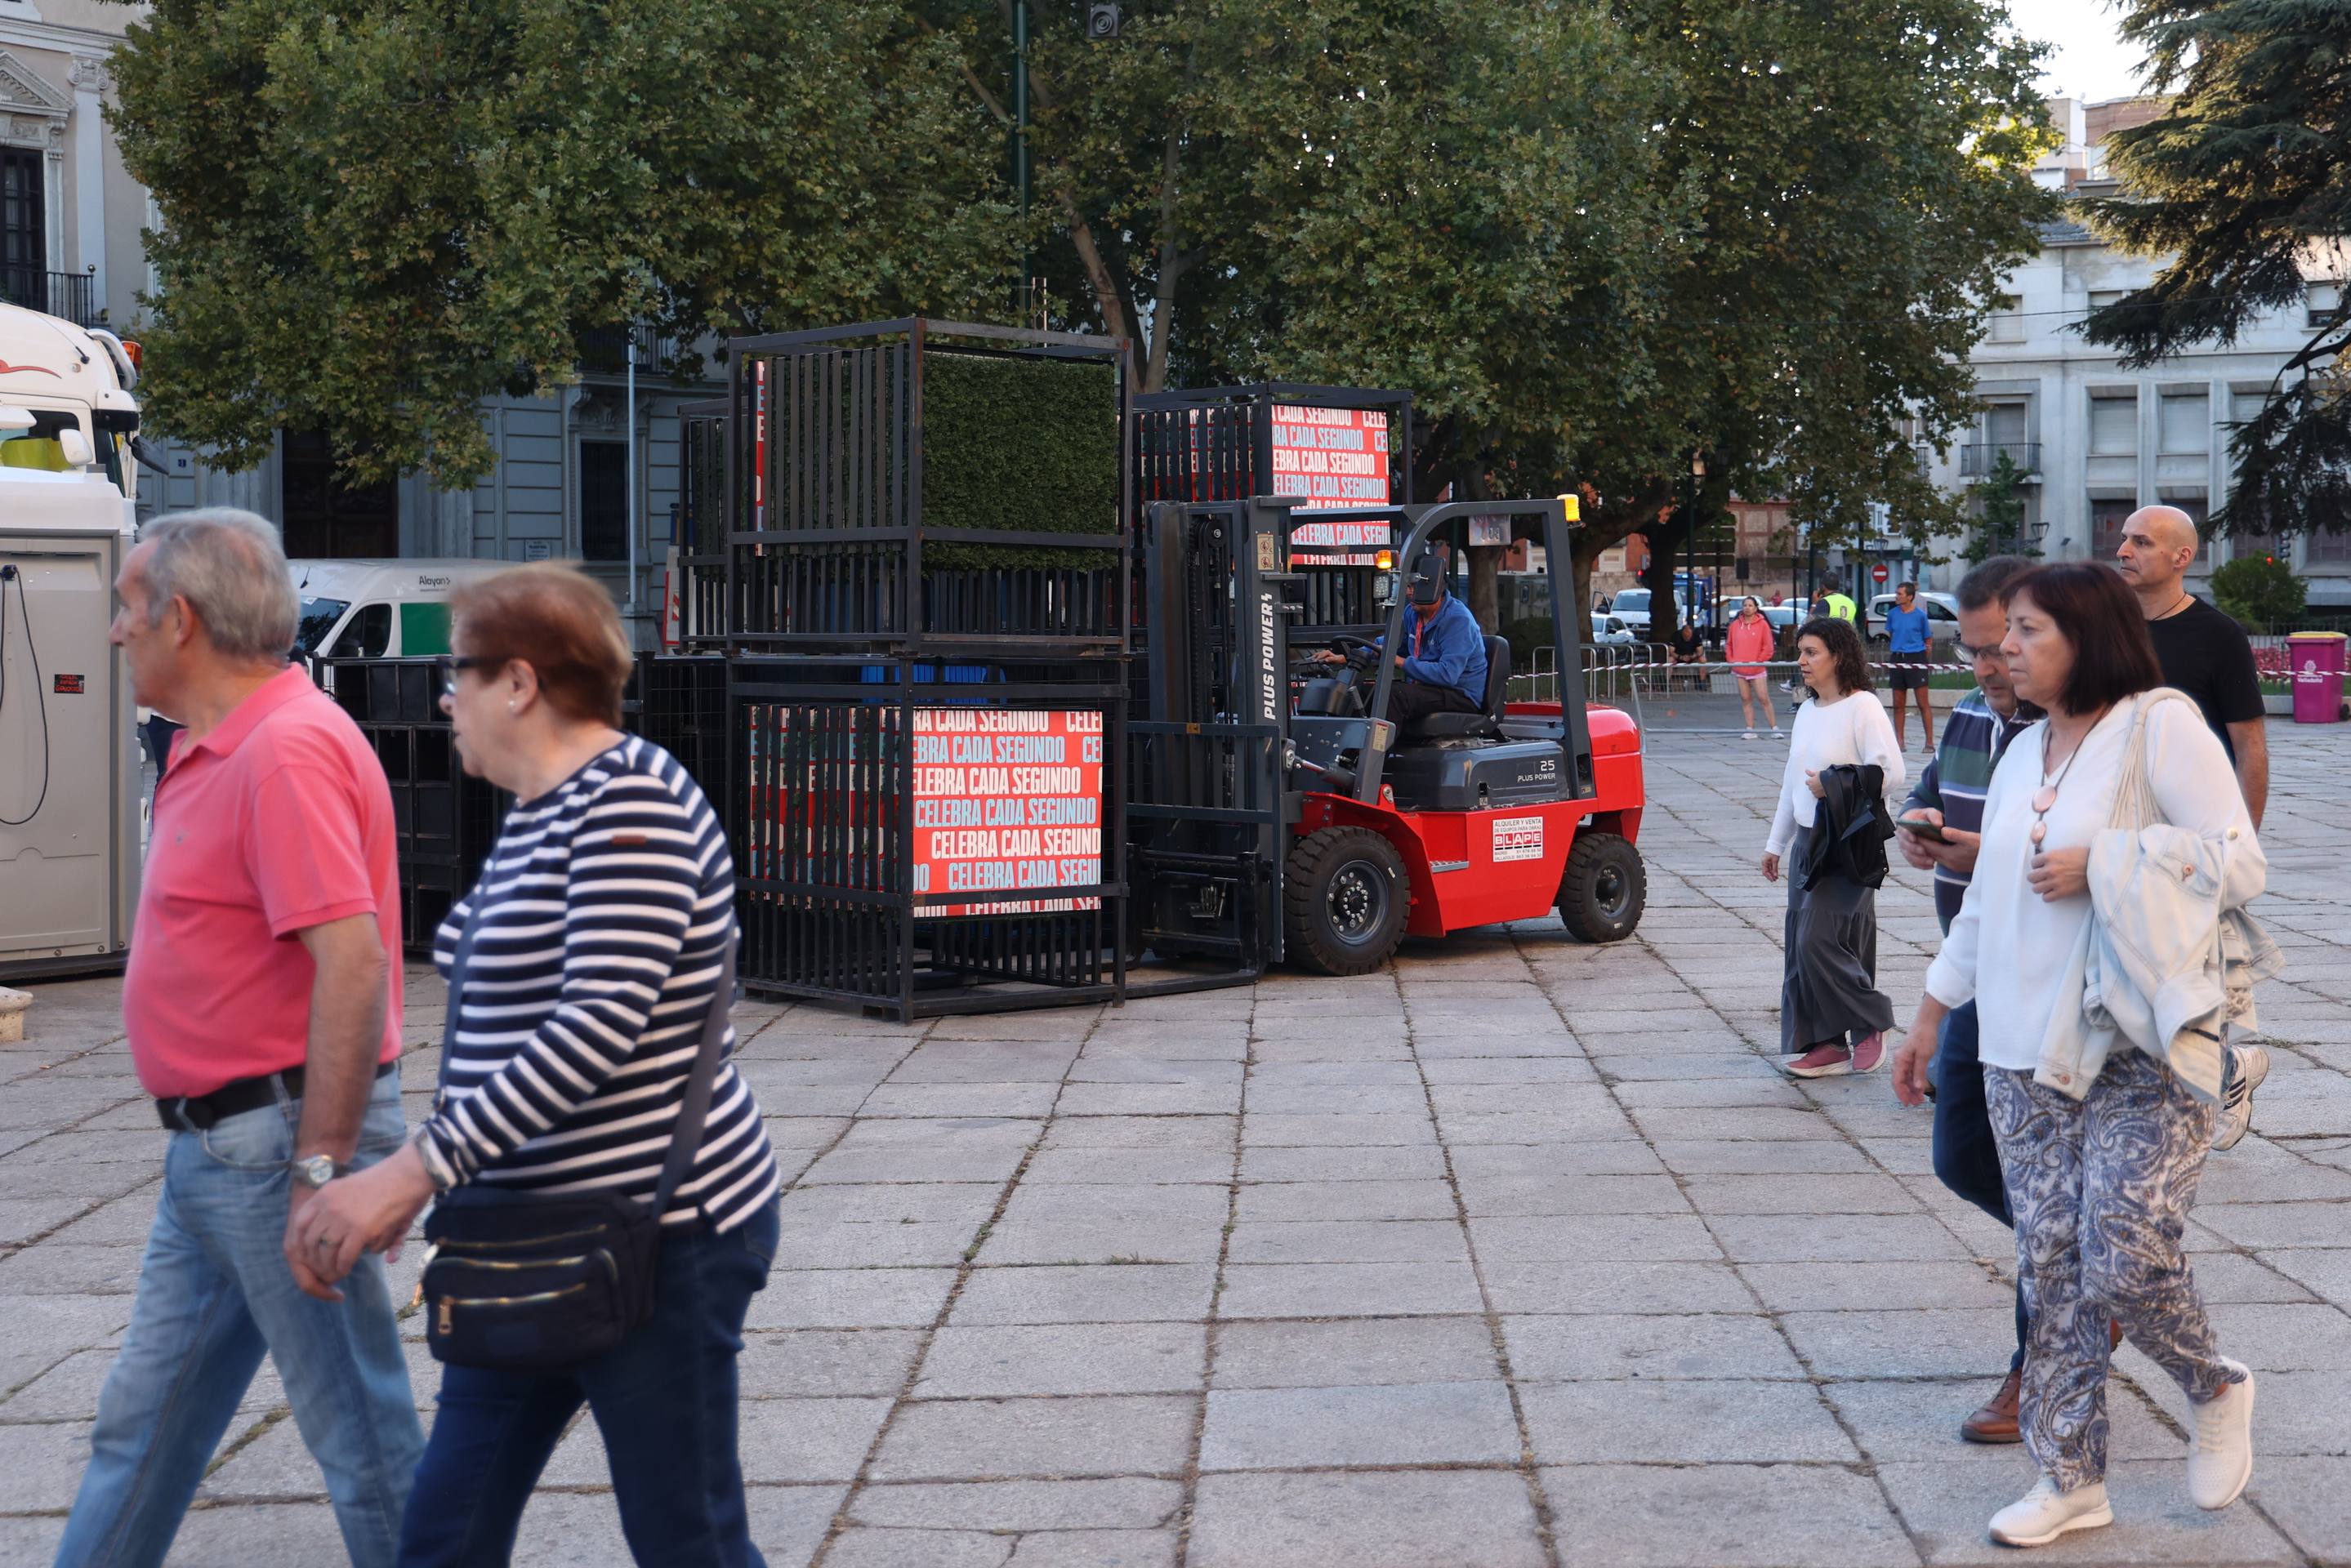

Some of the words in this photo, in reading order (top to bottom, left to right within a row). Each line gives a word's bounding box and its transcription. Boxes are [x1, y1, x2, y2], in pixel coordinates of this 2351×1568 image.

[1277, 405, 1305, 423] CADA
[1306, 407, 1352, 426] SEGUNDO
[1363, 410, 1387, 429] CELE
[1272, 425, 1288, 448] RA
[1290, 425, 1317, 448] CADA
[1318, 427, 1363, 451] SEGUNDO
[1301, 450, 1328, 473] CADA
[1329, 452, 1375, 475] SEGUNDO
[1313, 474, 1340, 497] CADA
[1341, 476, 1386, 499] SEGUNDO
[1291, 523, 1335, 545] CELEBRA
[1336, 524, 1363, 545] CADA
[1261, 602, 1274, 671] POWER
[1262, 674, 1276, 720] PLUS
[935, 710, 976, 732] CADA
[979, 710, 1049, 732] SEGUNDO
[1066, 711, 1102, 732] CELE
[952, 736, 993, 763] CADA
[996, 736, 1064, 763] SEGUNDO
[1082, 737, 1102, 763] CE
[1517, 774, 1533, 782] PLUS
[1535, 773, 1555, 781] POWER
[1540, 760, 1555, 771] 25
[969, 767, 1009, 795] CADA
[1012, 766, 1082, 794] SEGUNDO
[915, 799, 981, 827] CELEBRA
[985, 798, 1025, 826] CADA
[1028, 797, 1096, 825] SEGUNDO
[931, 830, 998, 859] CELEBRA
[1002, 829, 1042, 858] CADA
[1044, 827, 1101, 856] SEGUND
[1495, 832, 1541, 845] BLAPE
[948, 860, 1015, 890] CELEBRA
[1018, 859, 1058, 888] CADA
[1060, 858, 1101, 886] SEGU
